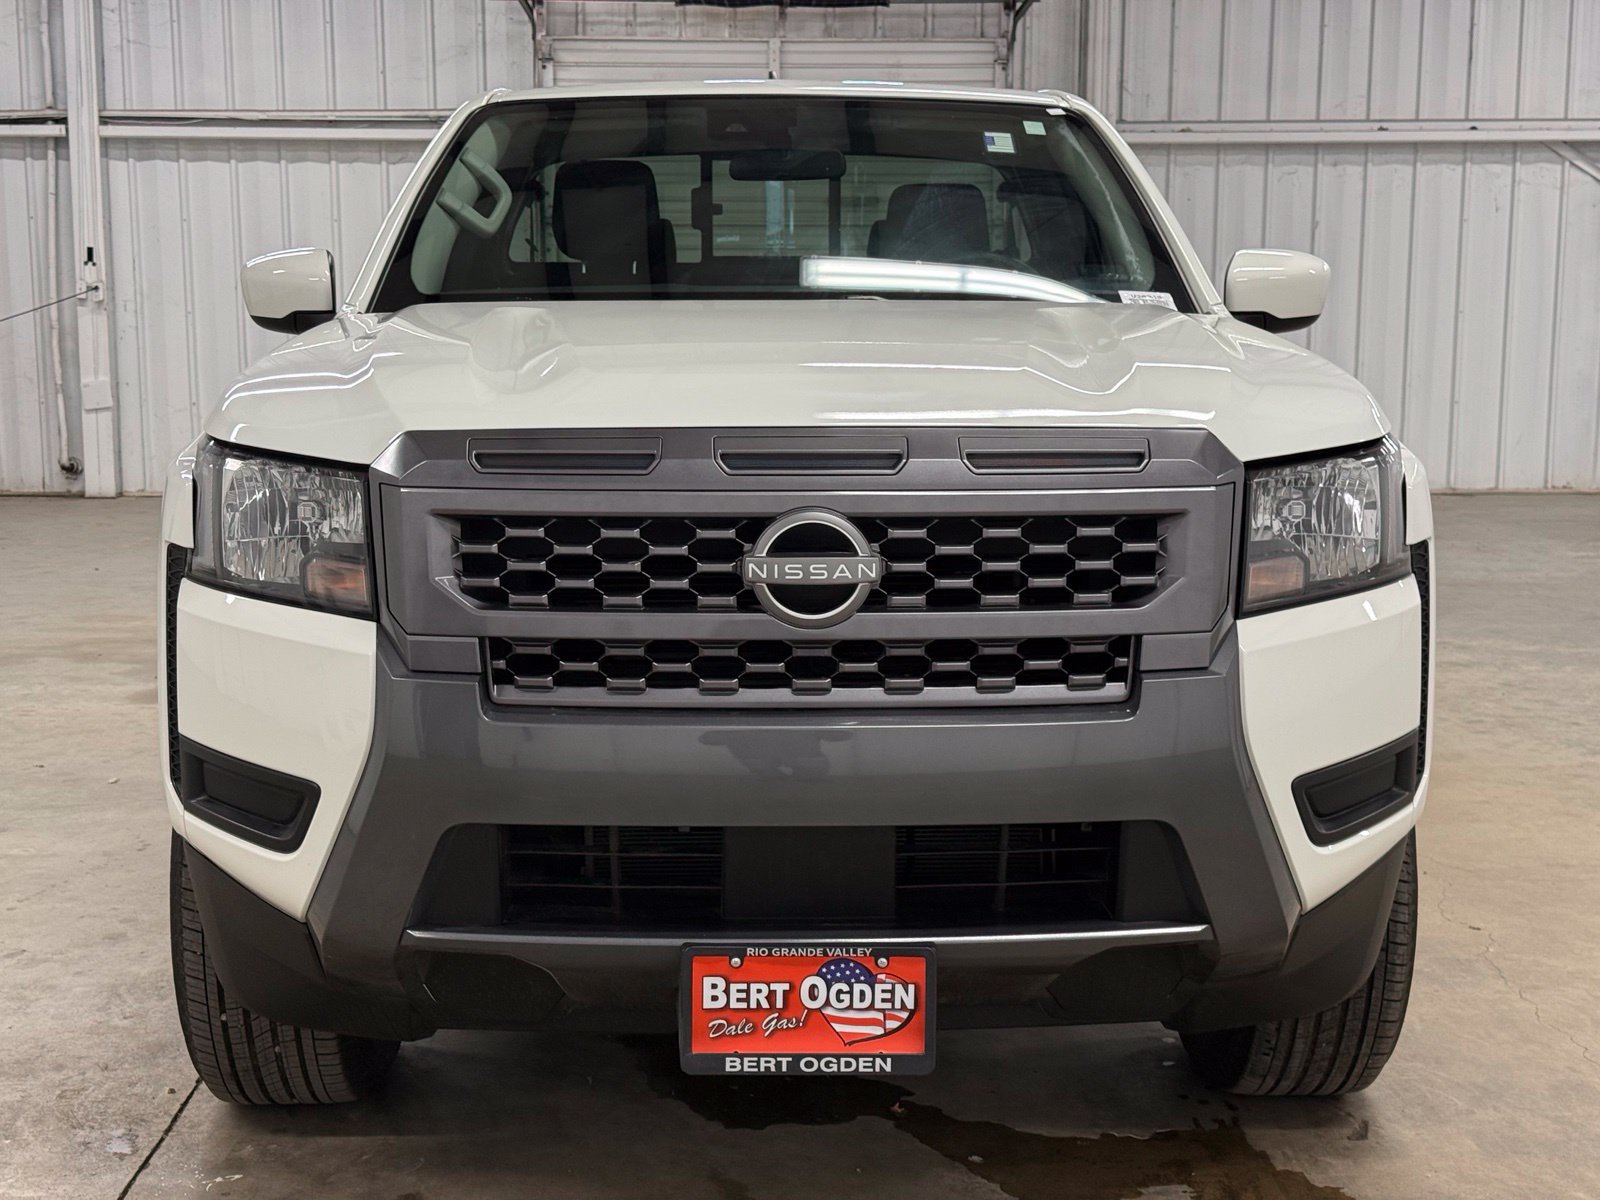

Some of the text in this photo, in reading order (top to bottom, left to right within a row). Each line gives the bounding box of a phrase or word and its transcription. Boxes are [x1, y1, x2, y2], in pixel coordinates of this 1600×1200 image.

[748, 562, 876, 579] NISSAN
[746, 947, 872, 957] RIO GRANDE VALLEY
[702, 975, 915, 1010] BERT OGDEN
[708, 1009, 808, 1038] Dale Gas!
[725, 1057, 892, 1073] BERT OGDEN
